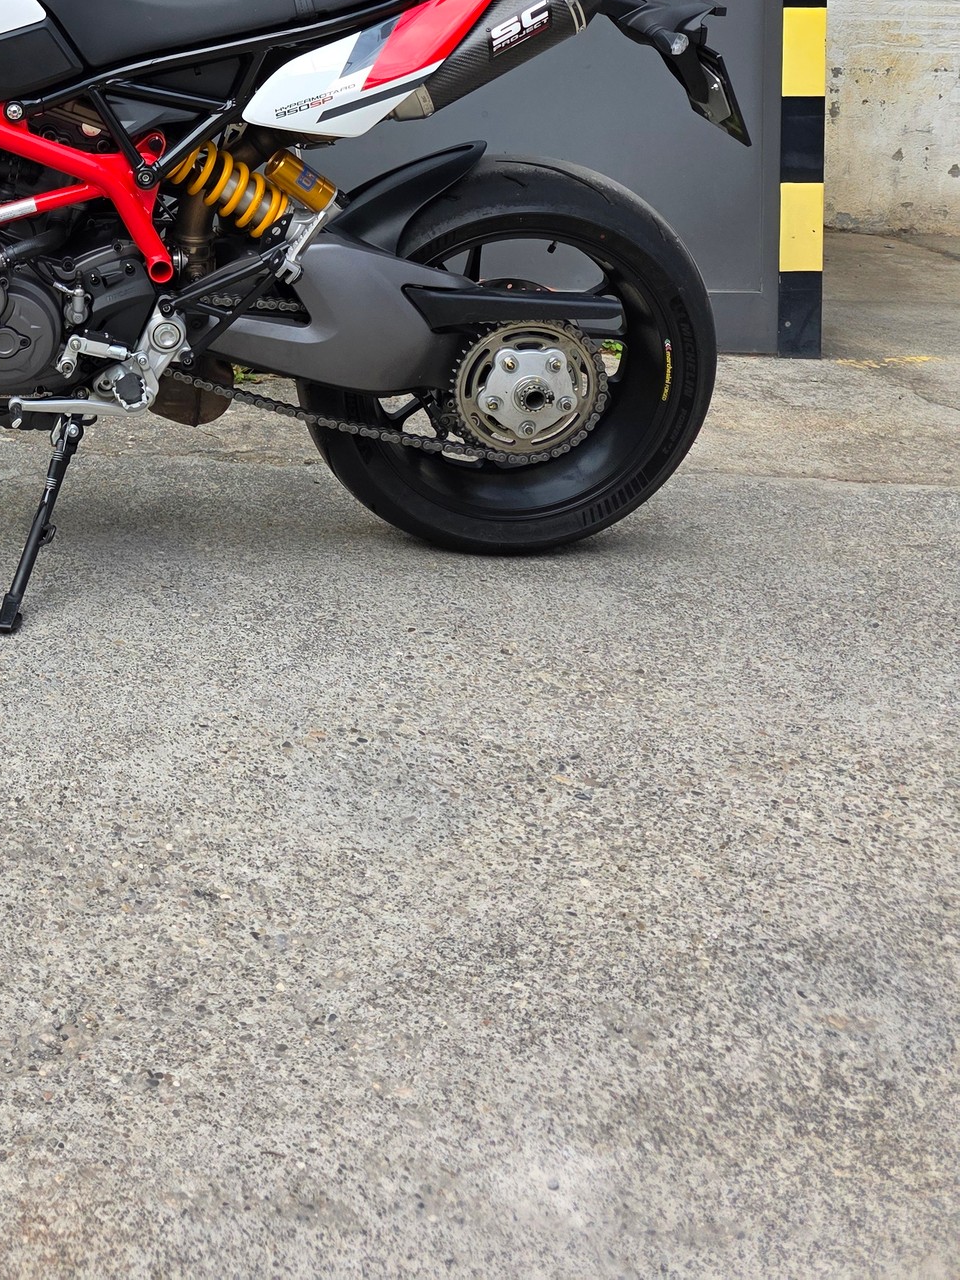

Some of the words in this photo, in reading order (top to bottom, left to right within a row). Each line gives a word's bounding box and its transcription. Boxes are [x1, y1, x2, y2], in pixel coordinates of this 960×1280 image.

[491, 0, 549, 47] SC
[493, 17, 549, 52] PROJECT
[680, 323, 697, 398] MICHELIN
